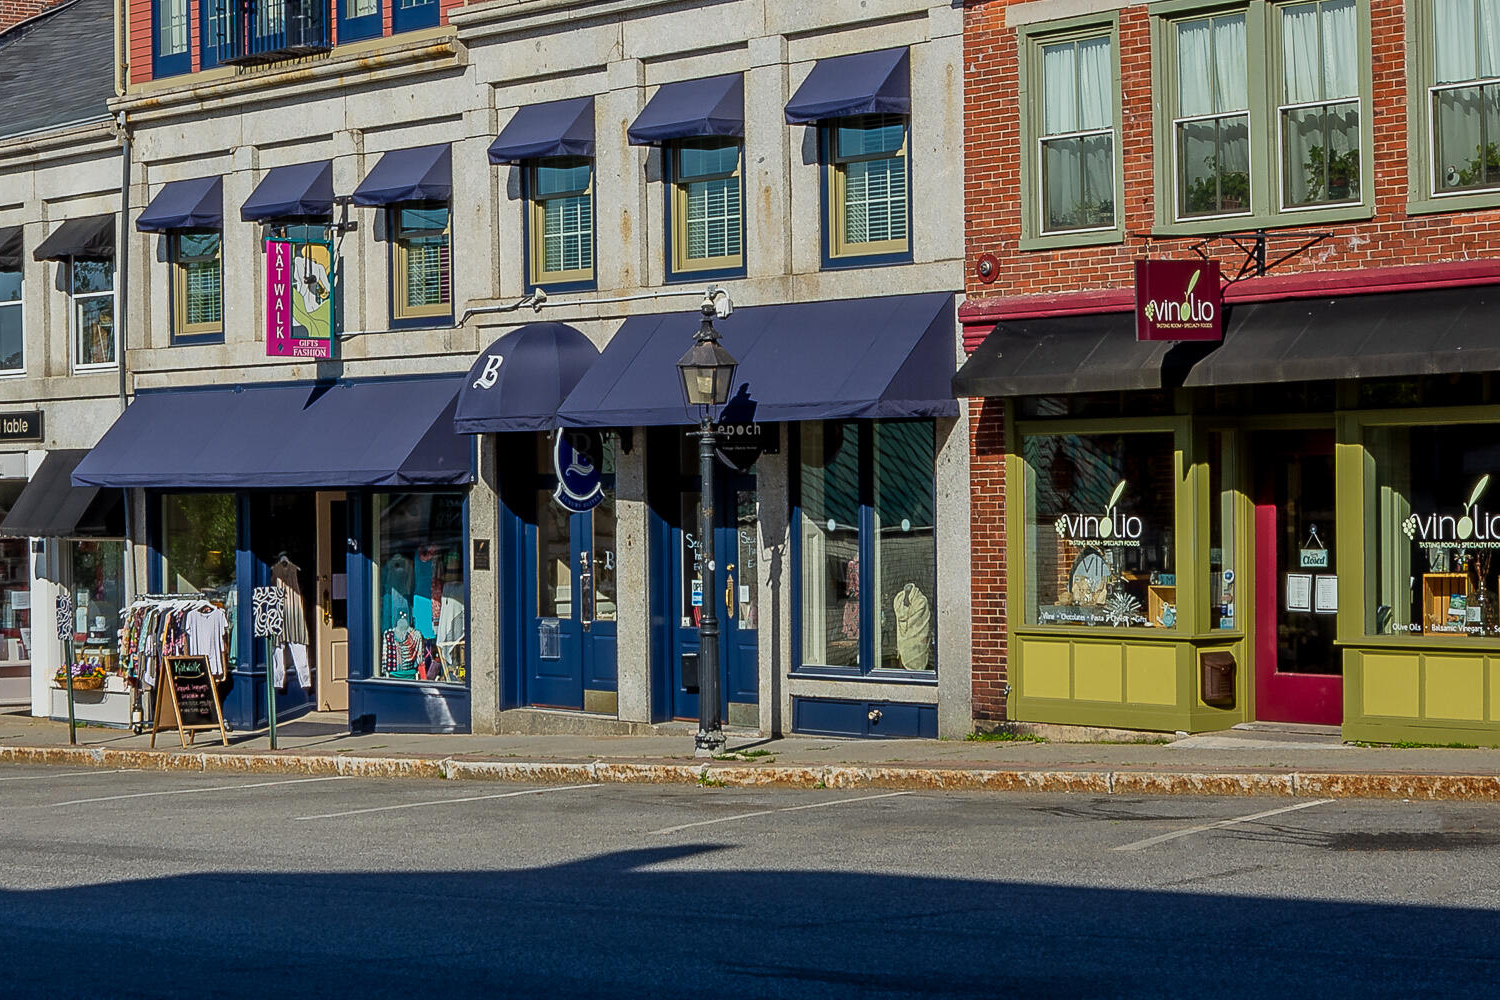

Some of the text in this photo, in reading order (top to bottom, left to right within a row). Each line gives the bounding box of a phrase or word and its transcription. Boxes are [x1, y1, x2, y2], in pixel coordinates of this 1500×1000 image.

[274, 242, 285, 339] KATWALK
[1148, 293, 1214, 321] vinolio
[293, 348, 326, 357] FASHION
[473, 355, 504, 389] B
[3, 418, 28, 433] table
[717, 422, 761, 440] epoch
[1061, 506, 1142, 538] vinolio
[1302, 555, 1325, 565] Closed
[1392, 623, 1483, 634] Olive Oils Balsamic Vinegars
